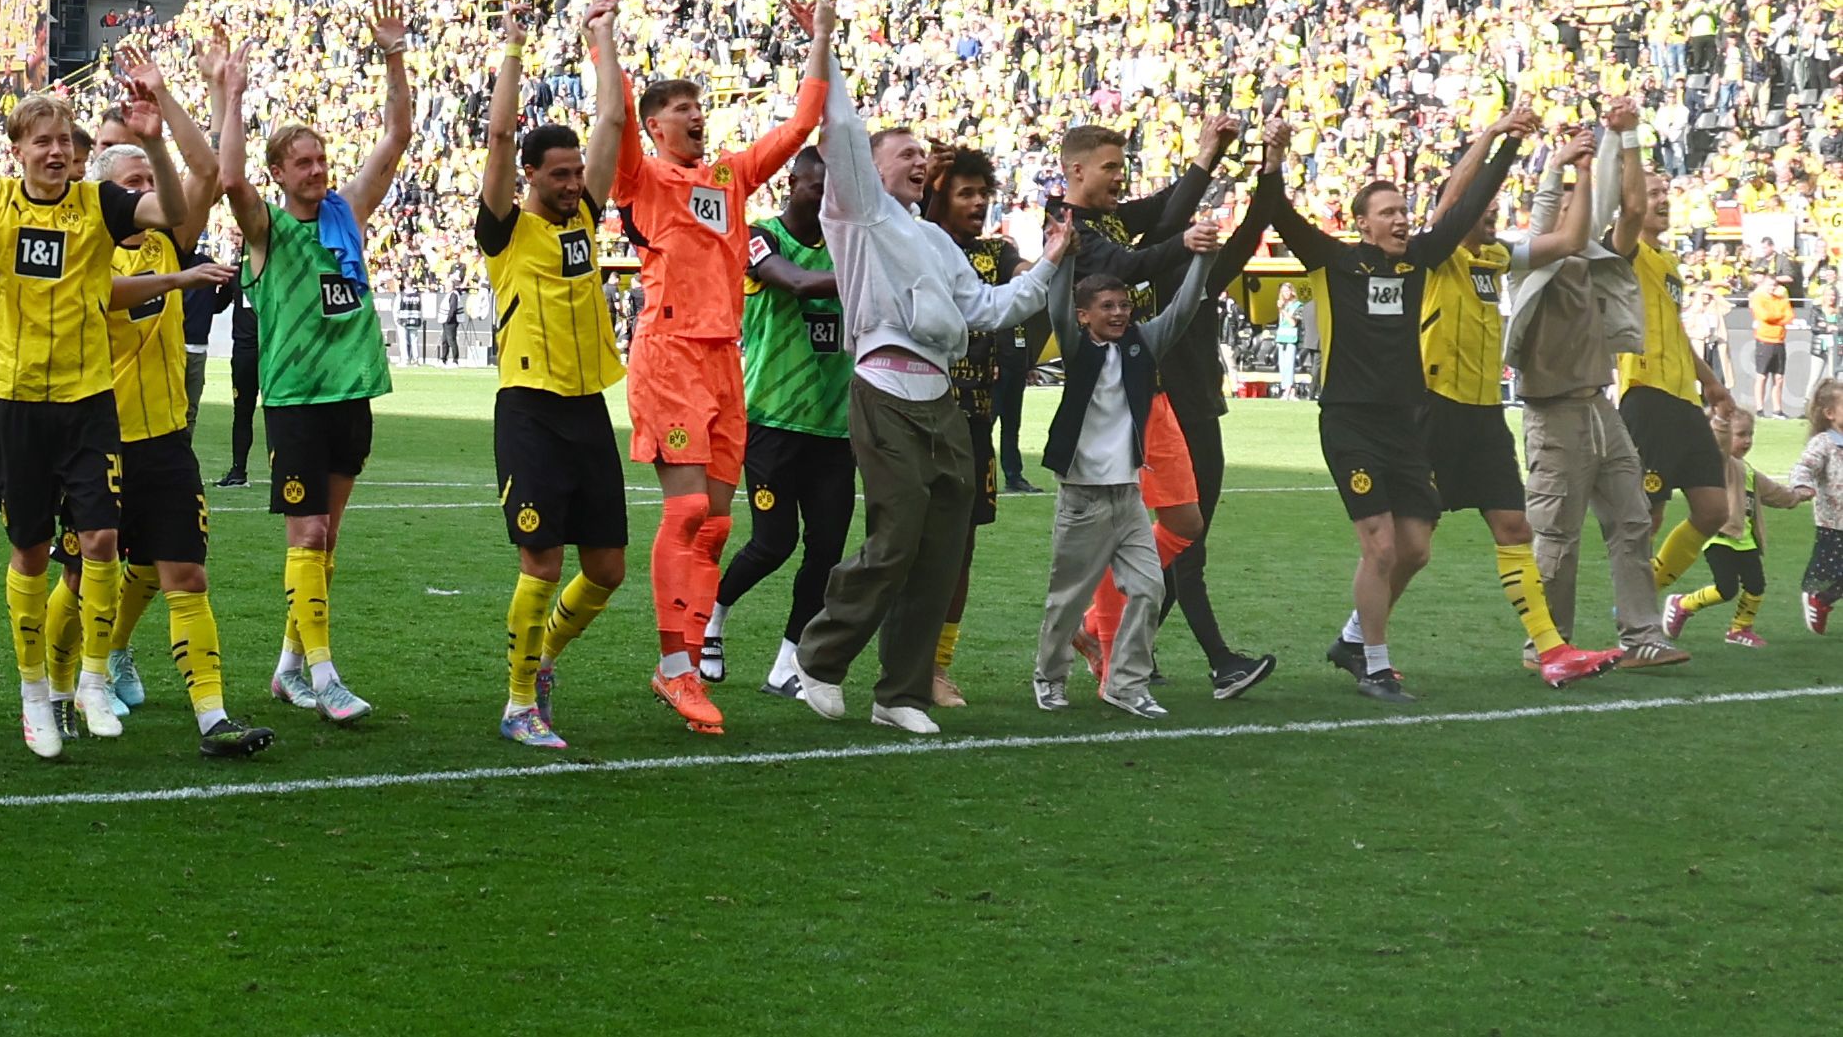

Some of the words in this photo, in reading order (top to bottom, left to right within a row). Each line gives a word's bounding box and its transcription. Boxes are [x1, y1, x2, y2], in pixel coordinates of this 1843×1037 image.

[693, 197, 721, 222] 1&1
[21, 238, 59, 266] 1&1
[563, 239, 589, 266] 1&1
[323, 283, 355, 305] 1&1
[1372, 286, 1399, 304] 1&1
[1471, 273, 1495, 294] 1&1
